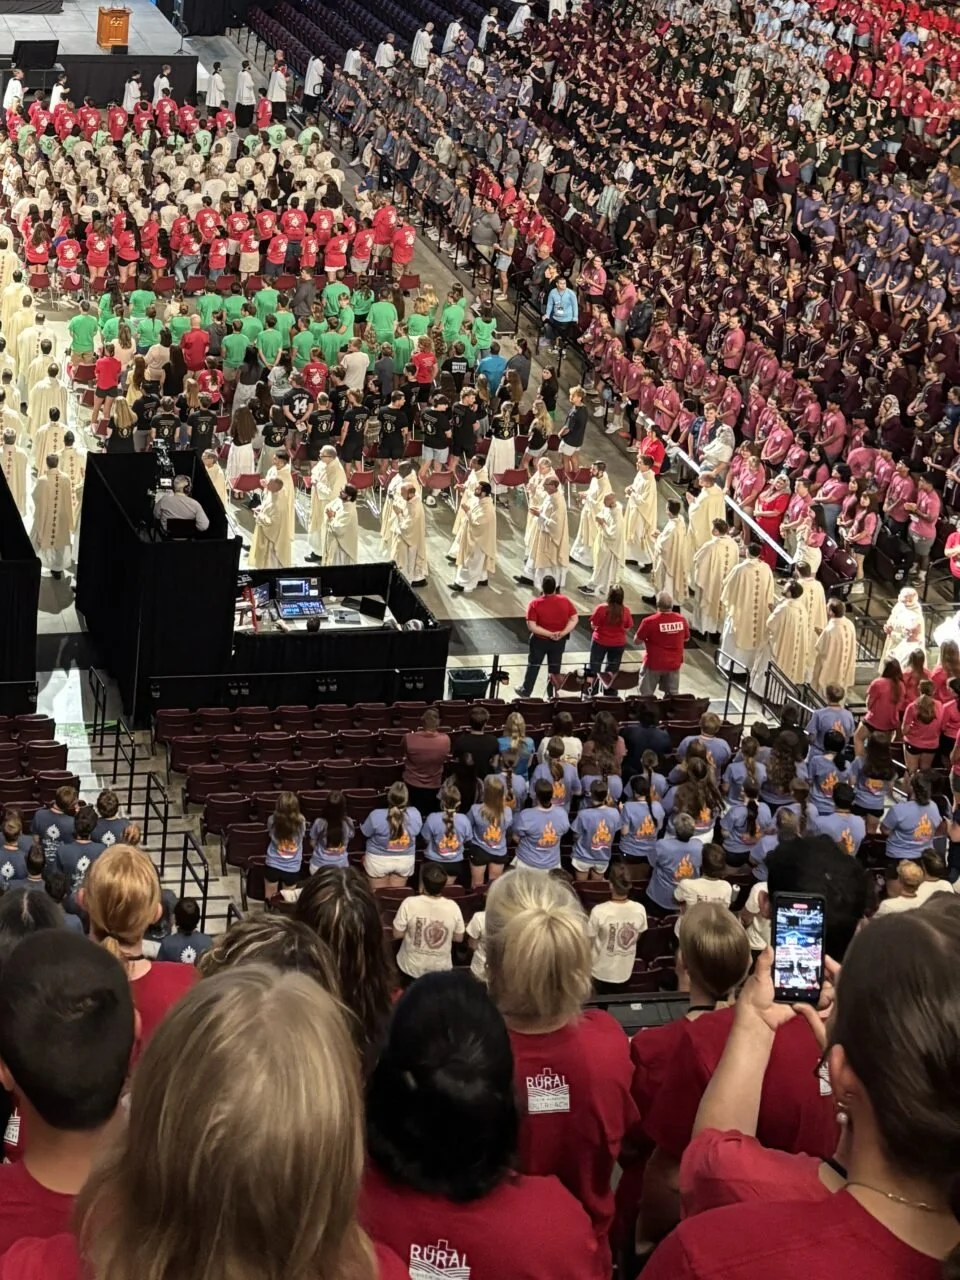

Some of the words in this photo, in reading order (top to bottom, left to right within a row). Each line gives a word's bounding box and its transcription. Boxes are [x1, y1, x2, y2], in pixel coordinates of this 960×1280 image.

[292, 399, 308, 414] 14
[526, 1074, 569, 1089] RURAL
[410, 1244, 471, 1269] RURAL
